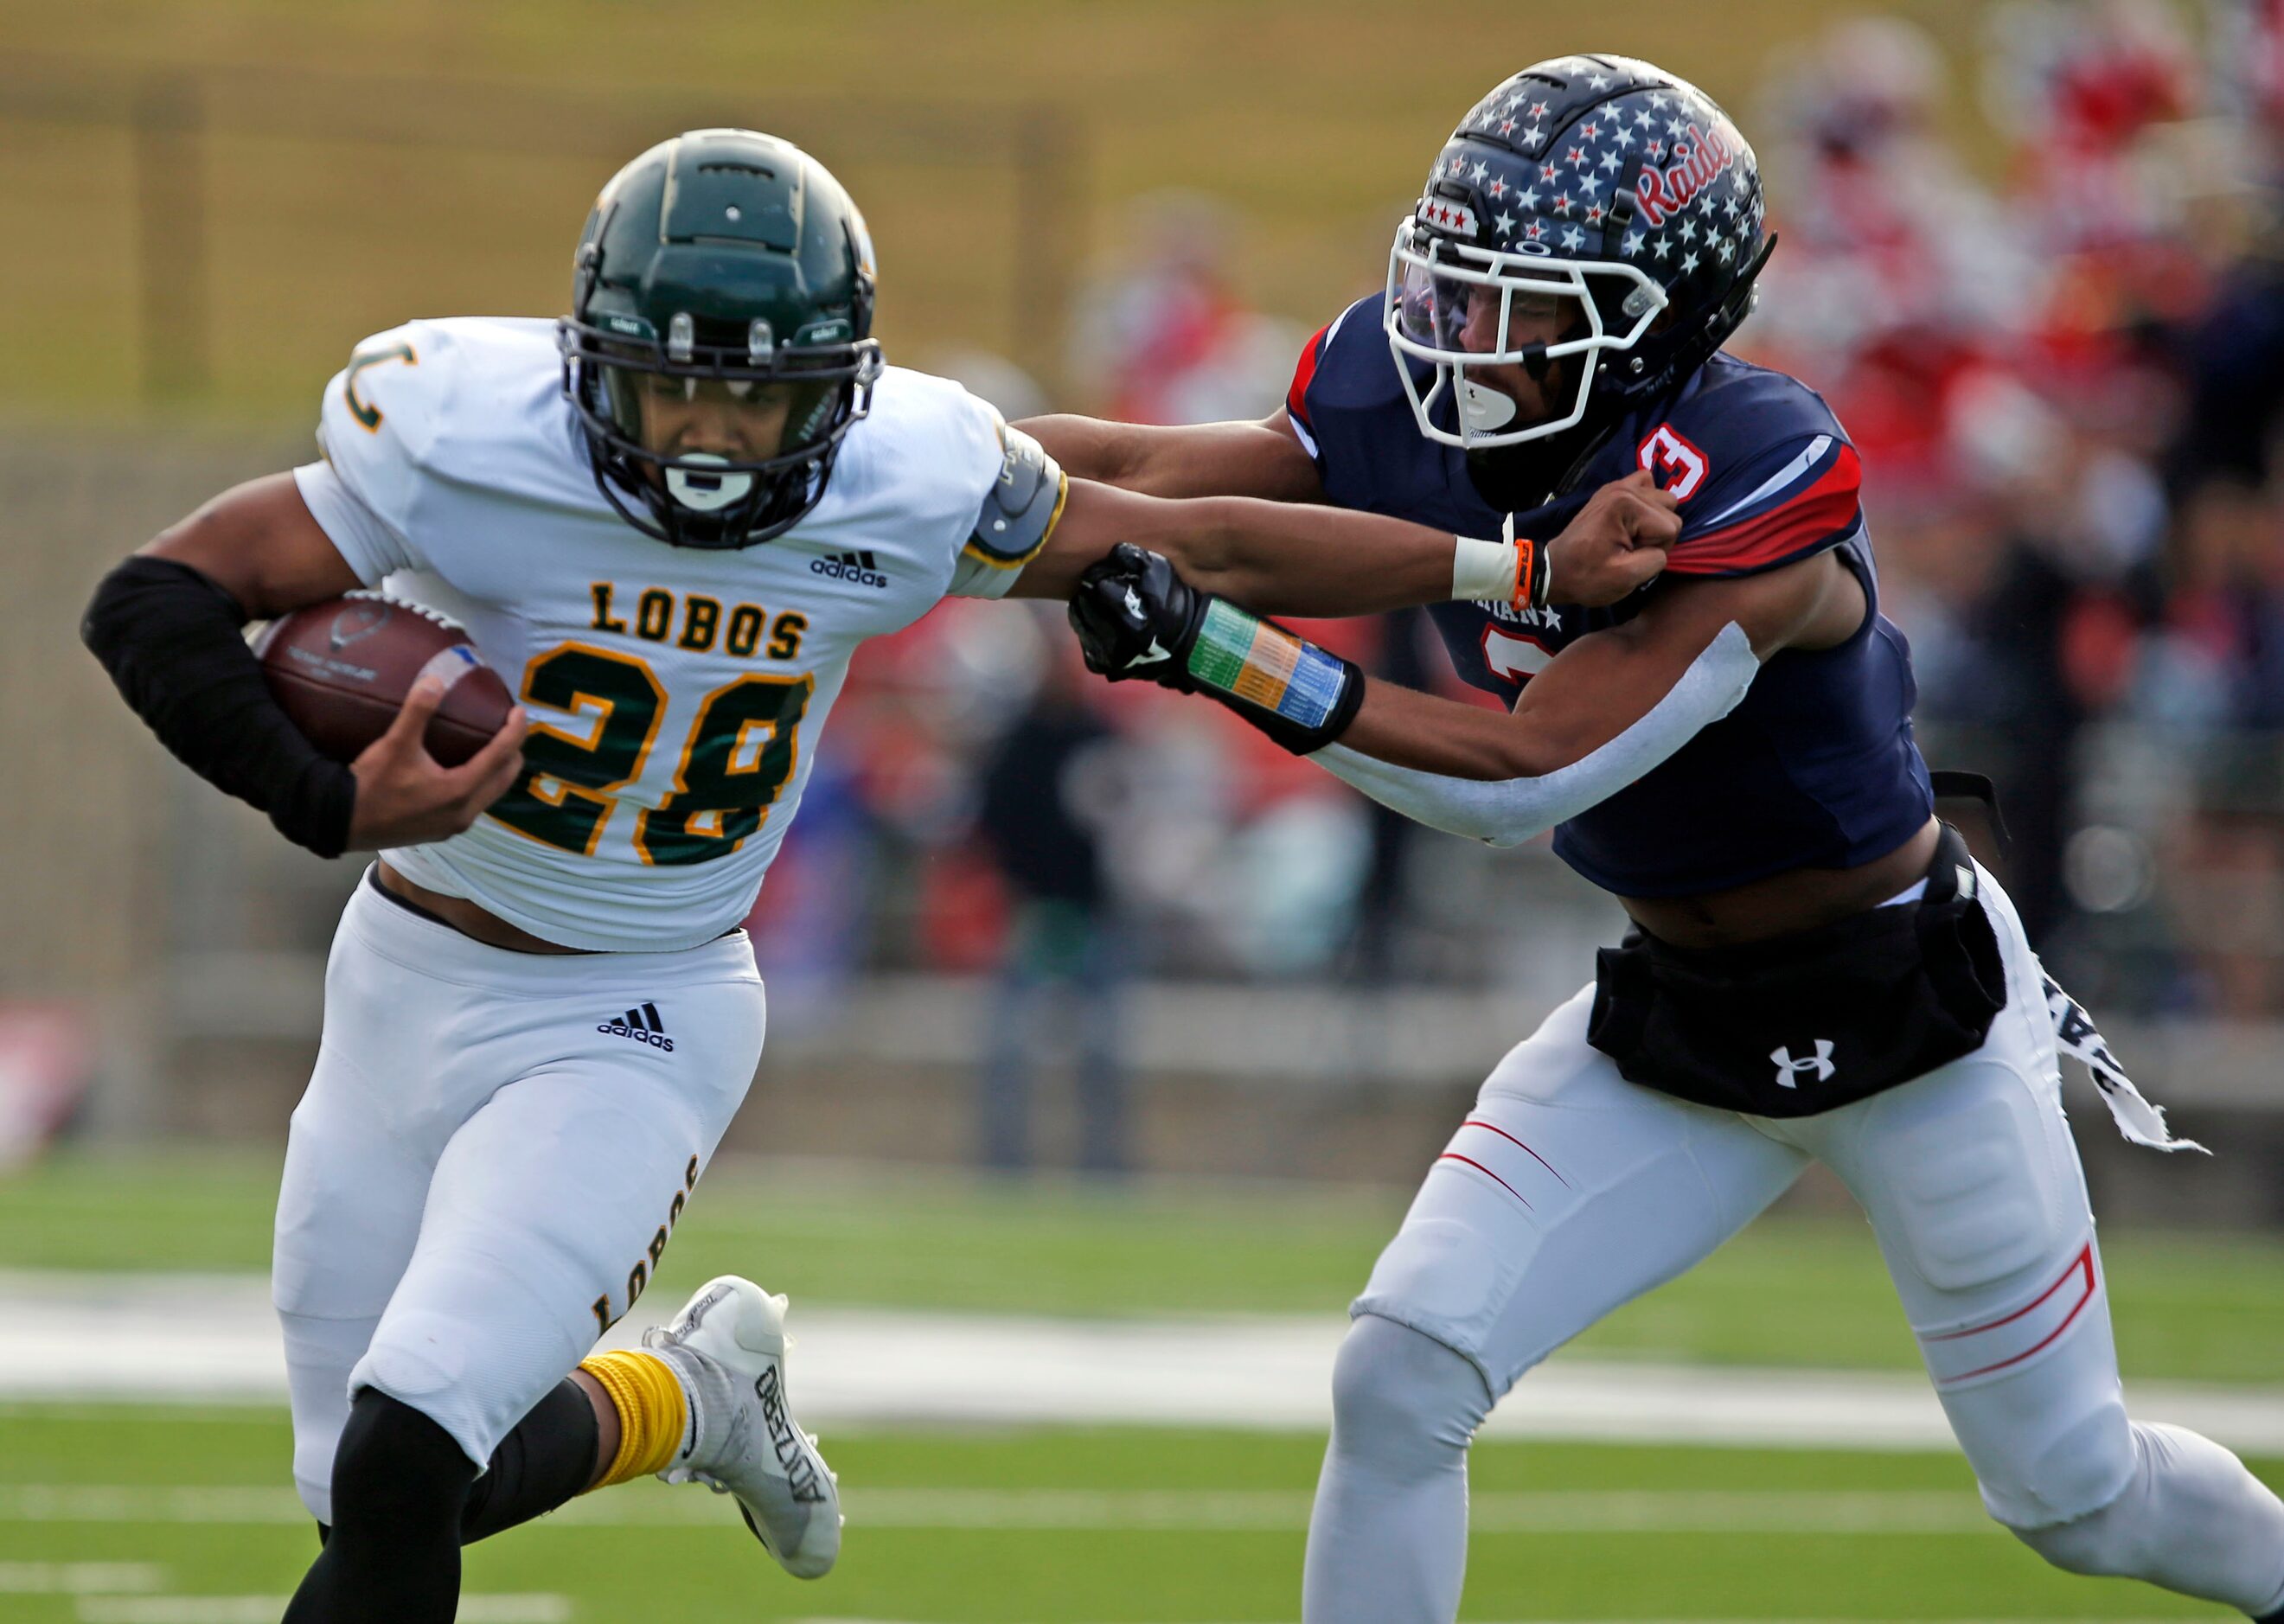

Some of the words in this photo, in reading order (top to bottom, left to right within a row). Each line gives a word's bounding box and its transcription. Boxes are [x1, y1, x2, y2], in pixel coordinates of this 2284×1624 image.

[1636, 421, 1710, 504] 3
[809, 559, 887, 589] adidas
[590, 581, 809, 661] LOBOS
[484, 640, 815, 866] 28
[597, 1023, 675, 1052] adidas
[754, 1364, 827, 1505] ADIZERO
